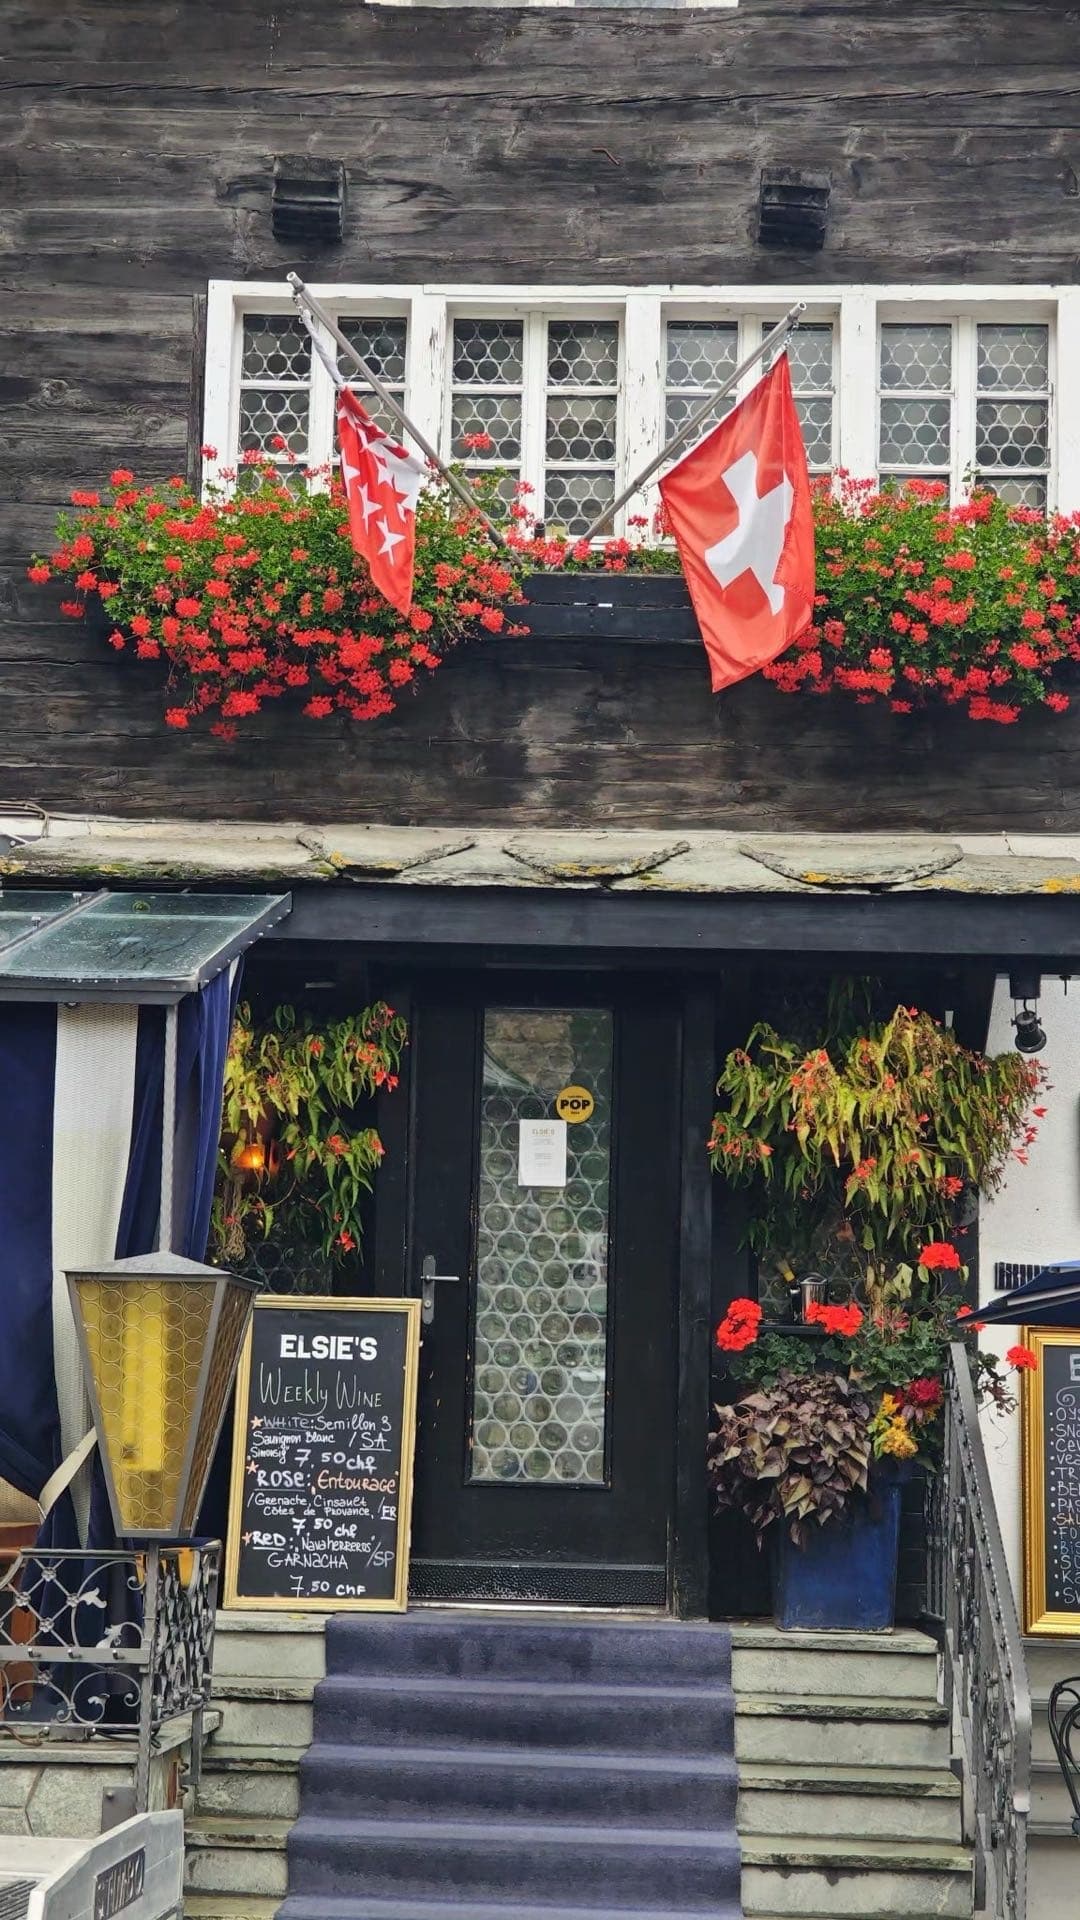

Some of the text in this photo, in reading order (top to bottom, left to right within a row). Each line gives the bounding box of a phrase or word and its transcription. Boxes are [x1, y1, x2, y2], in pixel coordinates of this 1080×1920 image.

[560, 1099, 590, 1109] POP
[280, 1334, 378, 1361] ELSIE'S
[305, 1431, 336, 1443] Blanc
